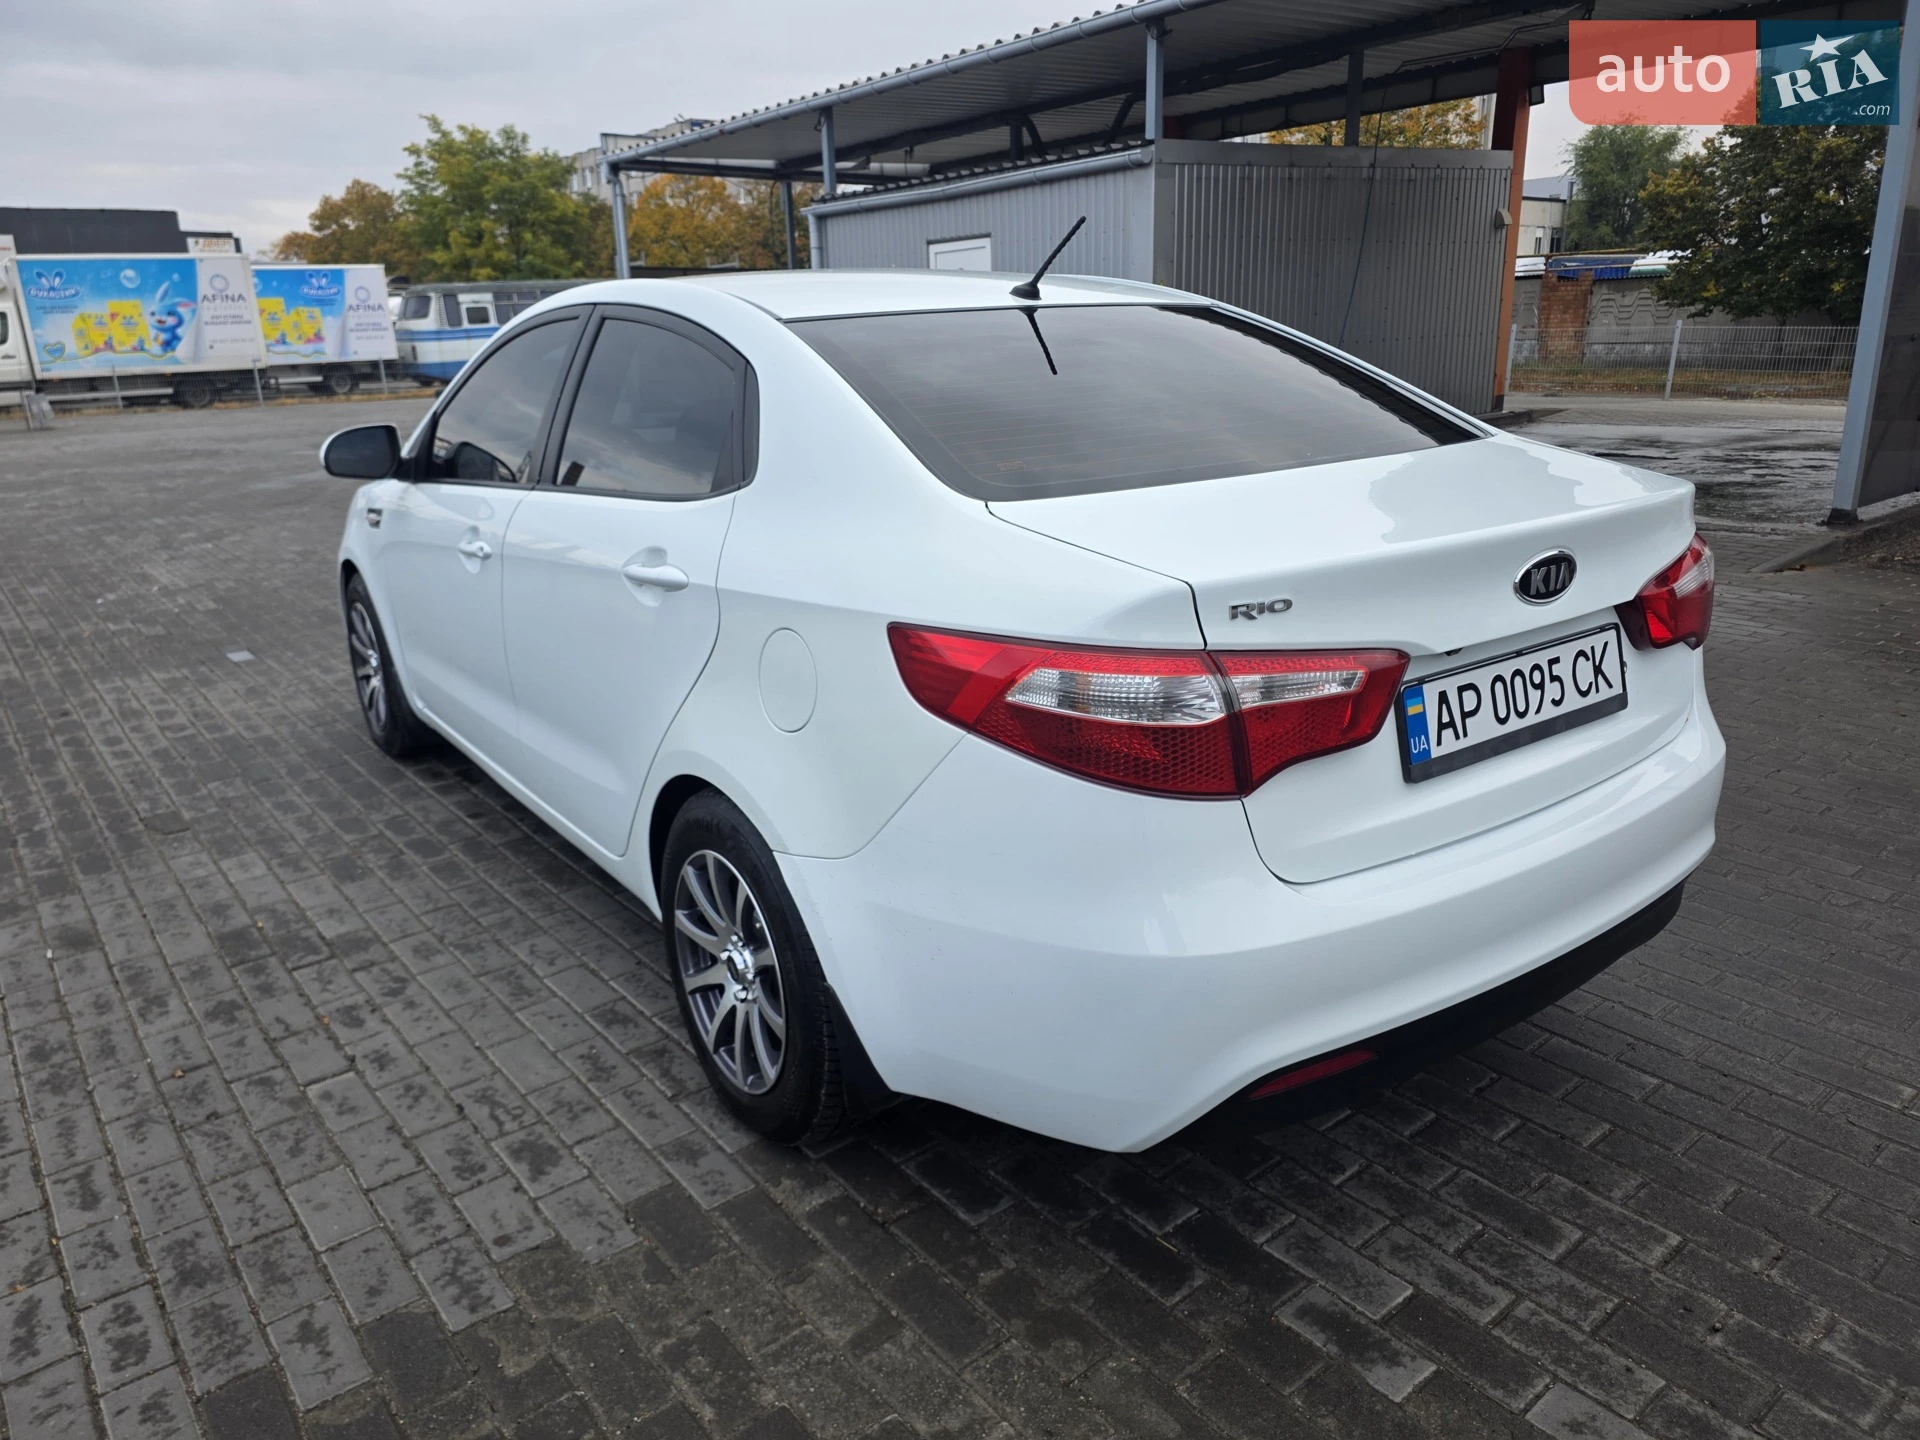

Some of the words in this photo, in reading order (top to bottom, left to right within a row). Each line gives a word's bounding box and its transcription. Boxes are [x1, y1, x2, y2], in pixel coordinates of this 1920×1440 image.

[201, 293, 247, 304] AFINA
[347, 303, 385, 313] AFINA
[1529, 562, 1571, 596] KIA
[1228, 598, 1293, 622] RIO
[1436, 682, 1482, 747] AP
[1490, 656, 1565, 726] 0095
[1571, 641, 1614, 698] CK
[1410, 735, 1429, 754] UA
